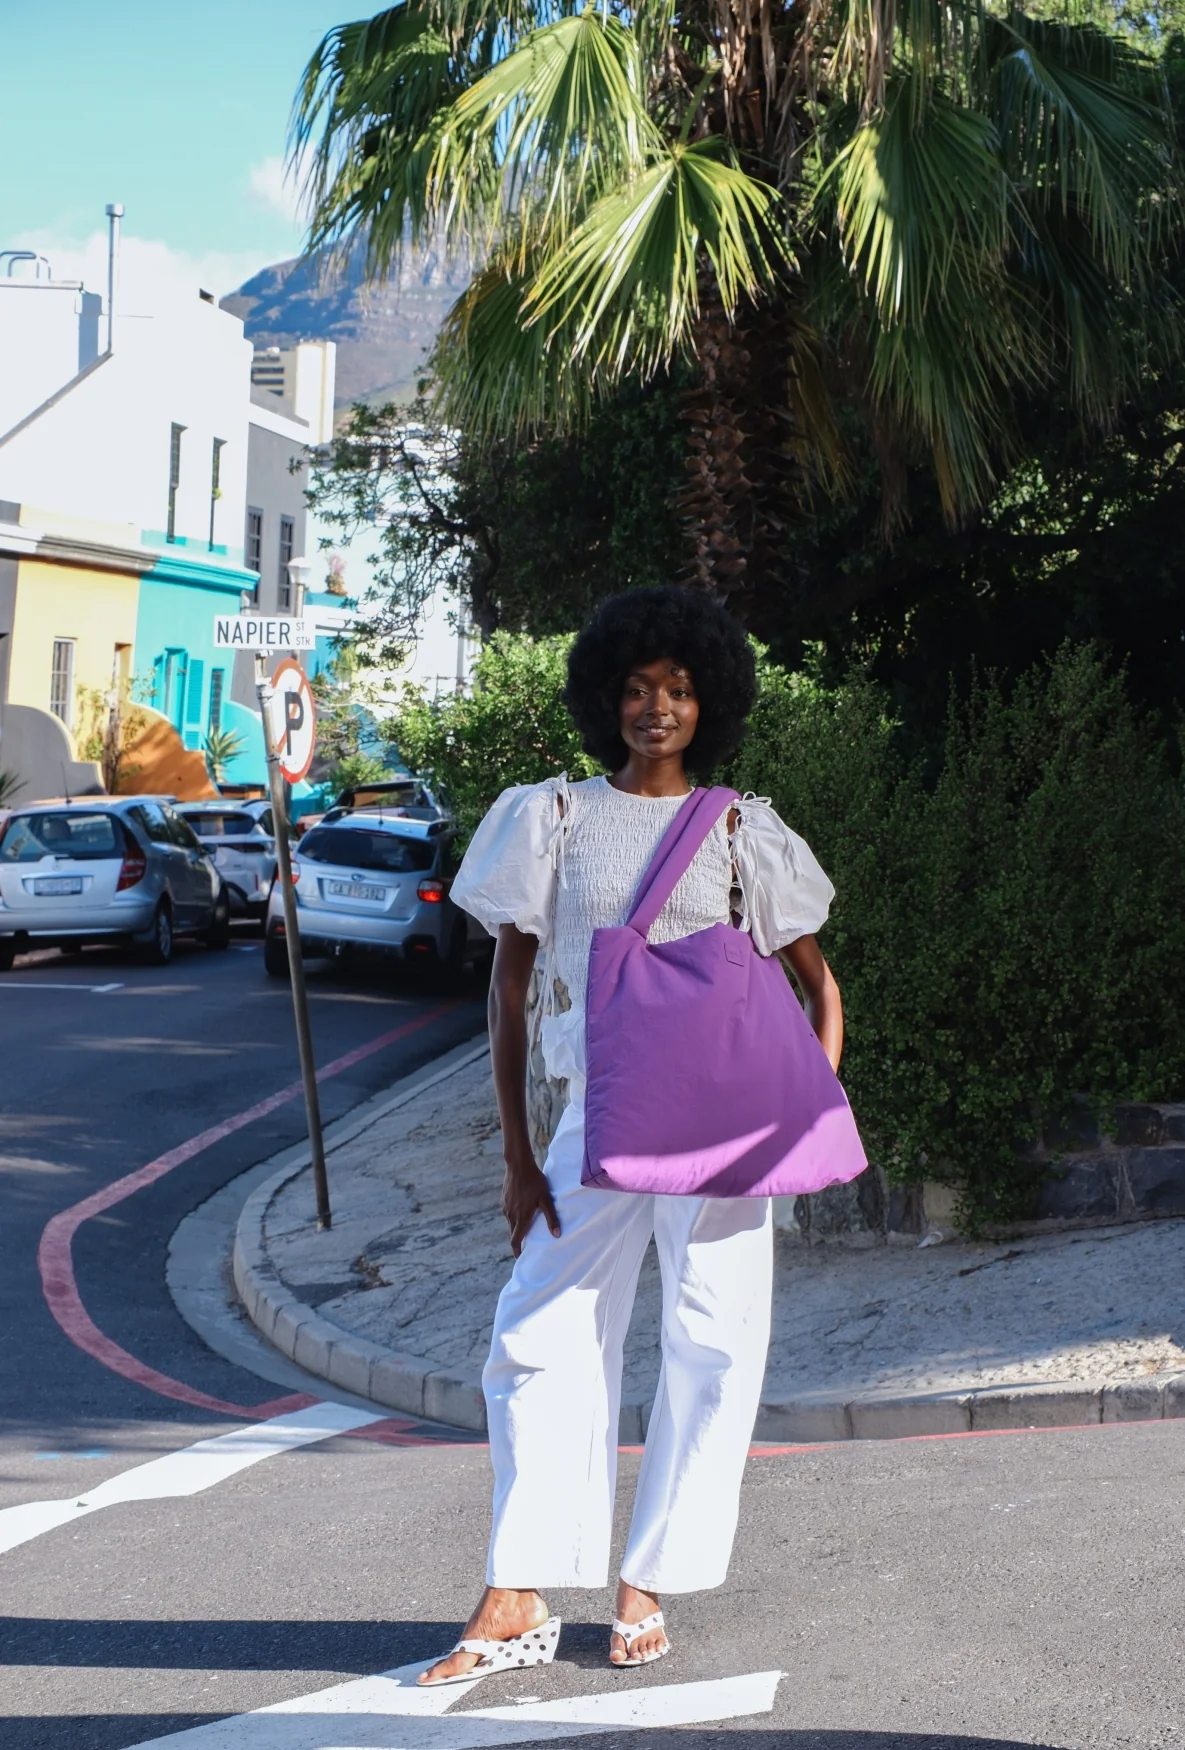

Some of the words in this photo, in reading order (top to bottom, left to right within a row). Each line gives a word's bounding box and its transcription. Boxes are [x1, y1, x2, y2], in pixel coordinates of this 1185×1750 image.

[217, 620, 291, 645] NAPIER
[296, 622, 305, 631] ST
[284, 691, 305, 757] P
